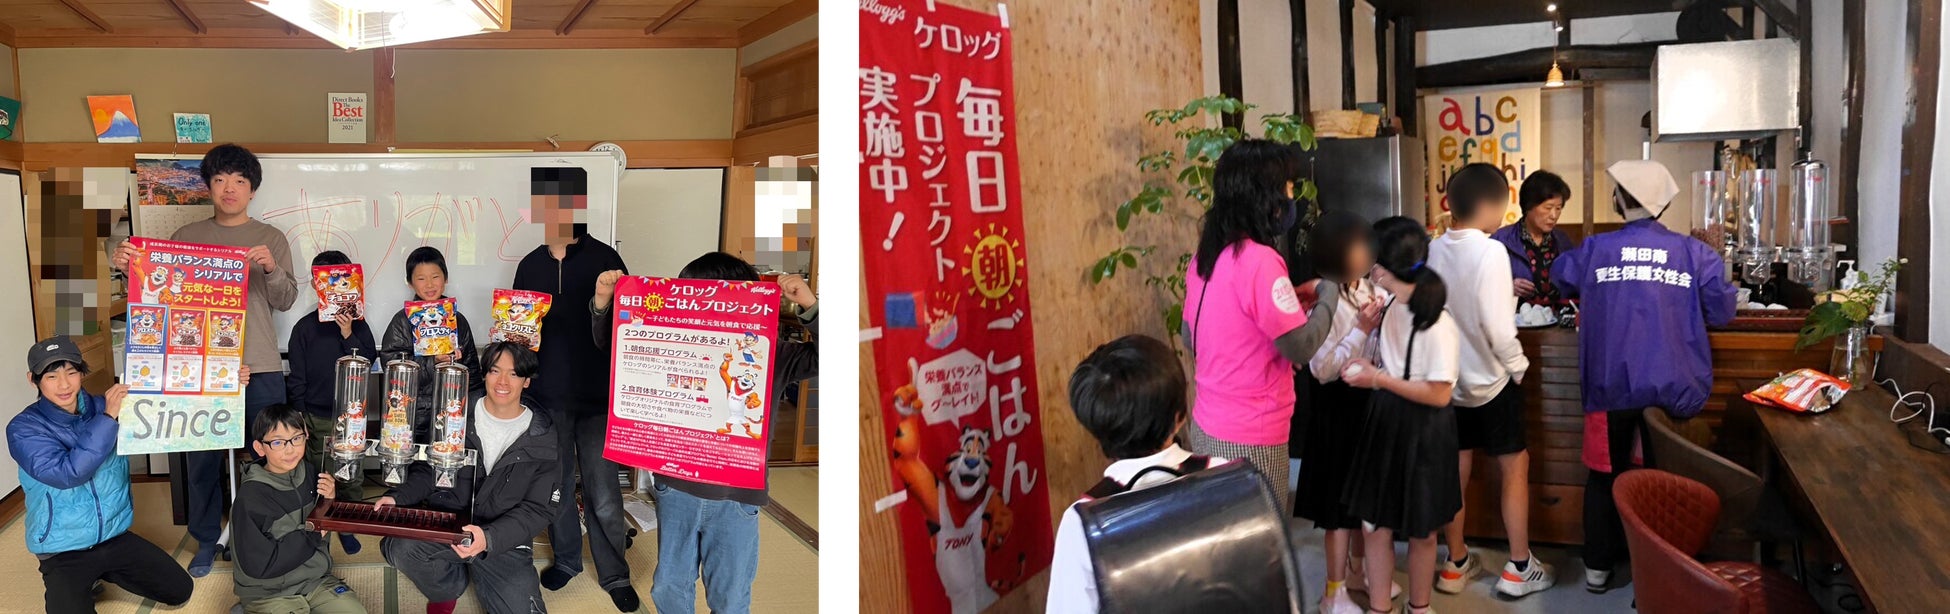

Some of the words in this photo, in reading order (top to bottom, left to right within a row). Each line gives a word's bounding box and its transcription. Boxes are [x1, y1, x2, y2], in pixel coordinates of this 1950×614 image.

[914, 16, 1002, 60] ケロッグ
[333, 102, 363, 117] Best
[910, 72, 956, 283] プロジェクト
[150, 252, 244, 270] 栄養バランス満点の
[1621, 247, 1668, 264] 瀬田南
[194, 268, 243, 282] シリアルで
[1595, 265, 1692, 288] 更生保護女性会
[182, 282, 242, 296] 元気な一日を
[670, 284, 718, 298] ケロッグ
[173, 294, 241, 307] スタートしよう!
[420, 327, 451, 336] フロスティ
[625, 328, 730, 346] 2つのプログラムがあるよ!
[925, 364, 982, 385] 栄養バランス
[133, 398, 231, 440] Since
[945, 533, 974, 550] TONY
